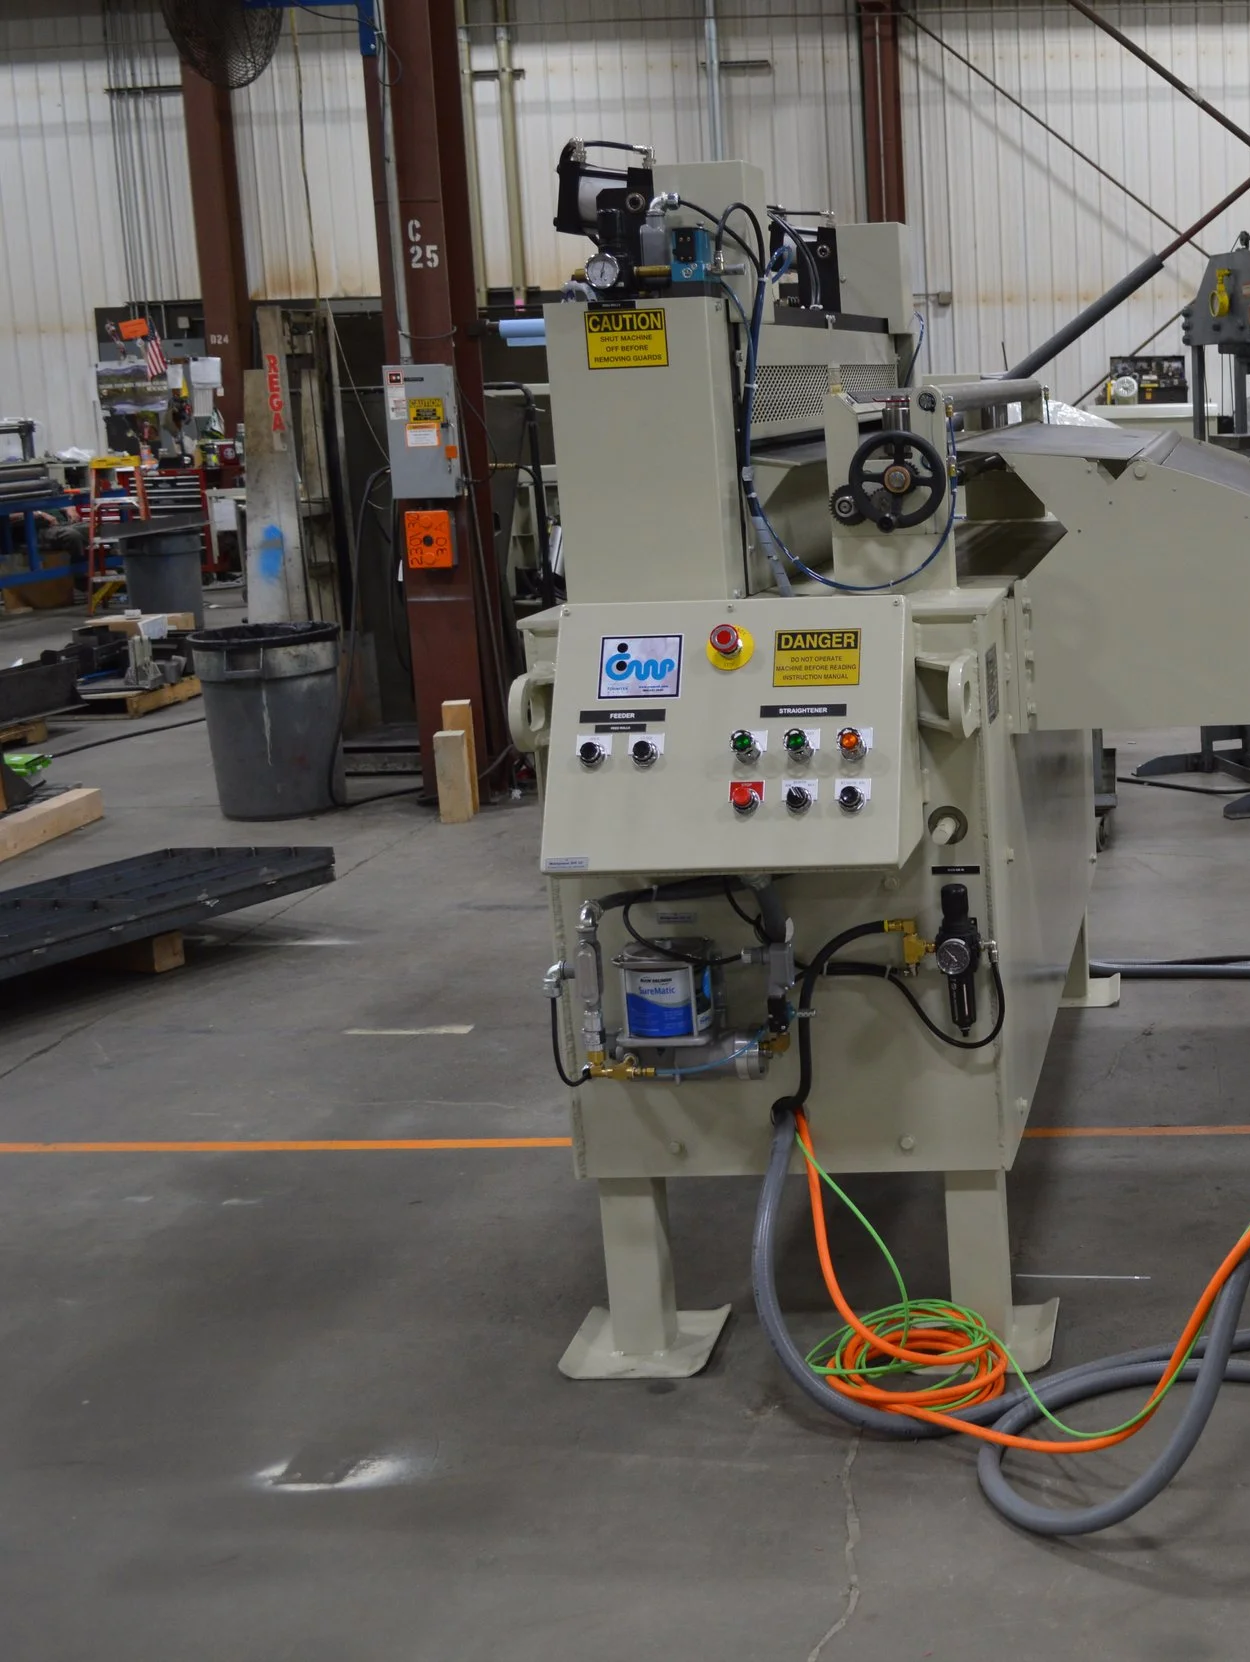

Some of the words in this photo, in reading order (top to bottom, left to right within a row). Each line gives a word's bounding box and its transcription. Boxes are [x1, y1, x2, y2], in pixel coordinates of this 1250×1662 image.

[408, 219, 421, 241] C
[409, 244, 439, 268] 25
[588, 312, 662, 332] CAUTION
[620, 333, 653, 341] MACHINE
[594, 355, 632, 363] REMOVING
[632, 353, 662, 361] GUARDS
[265, 353, 285, 431] REGA
[780, 632, 856, 649] DANGER
